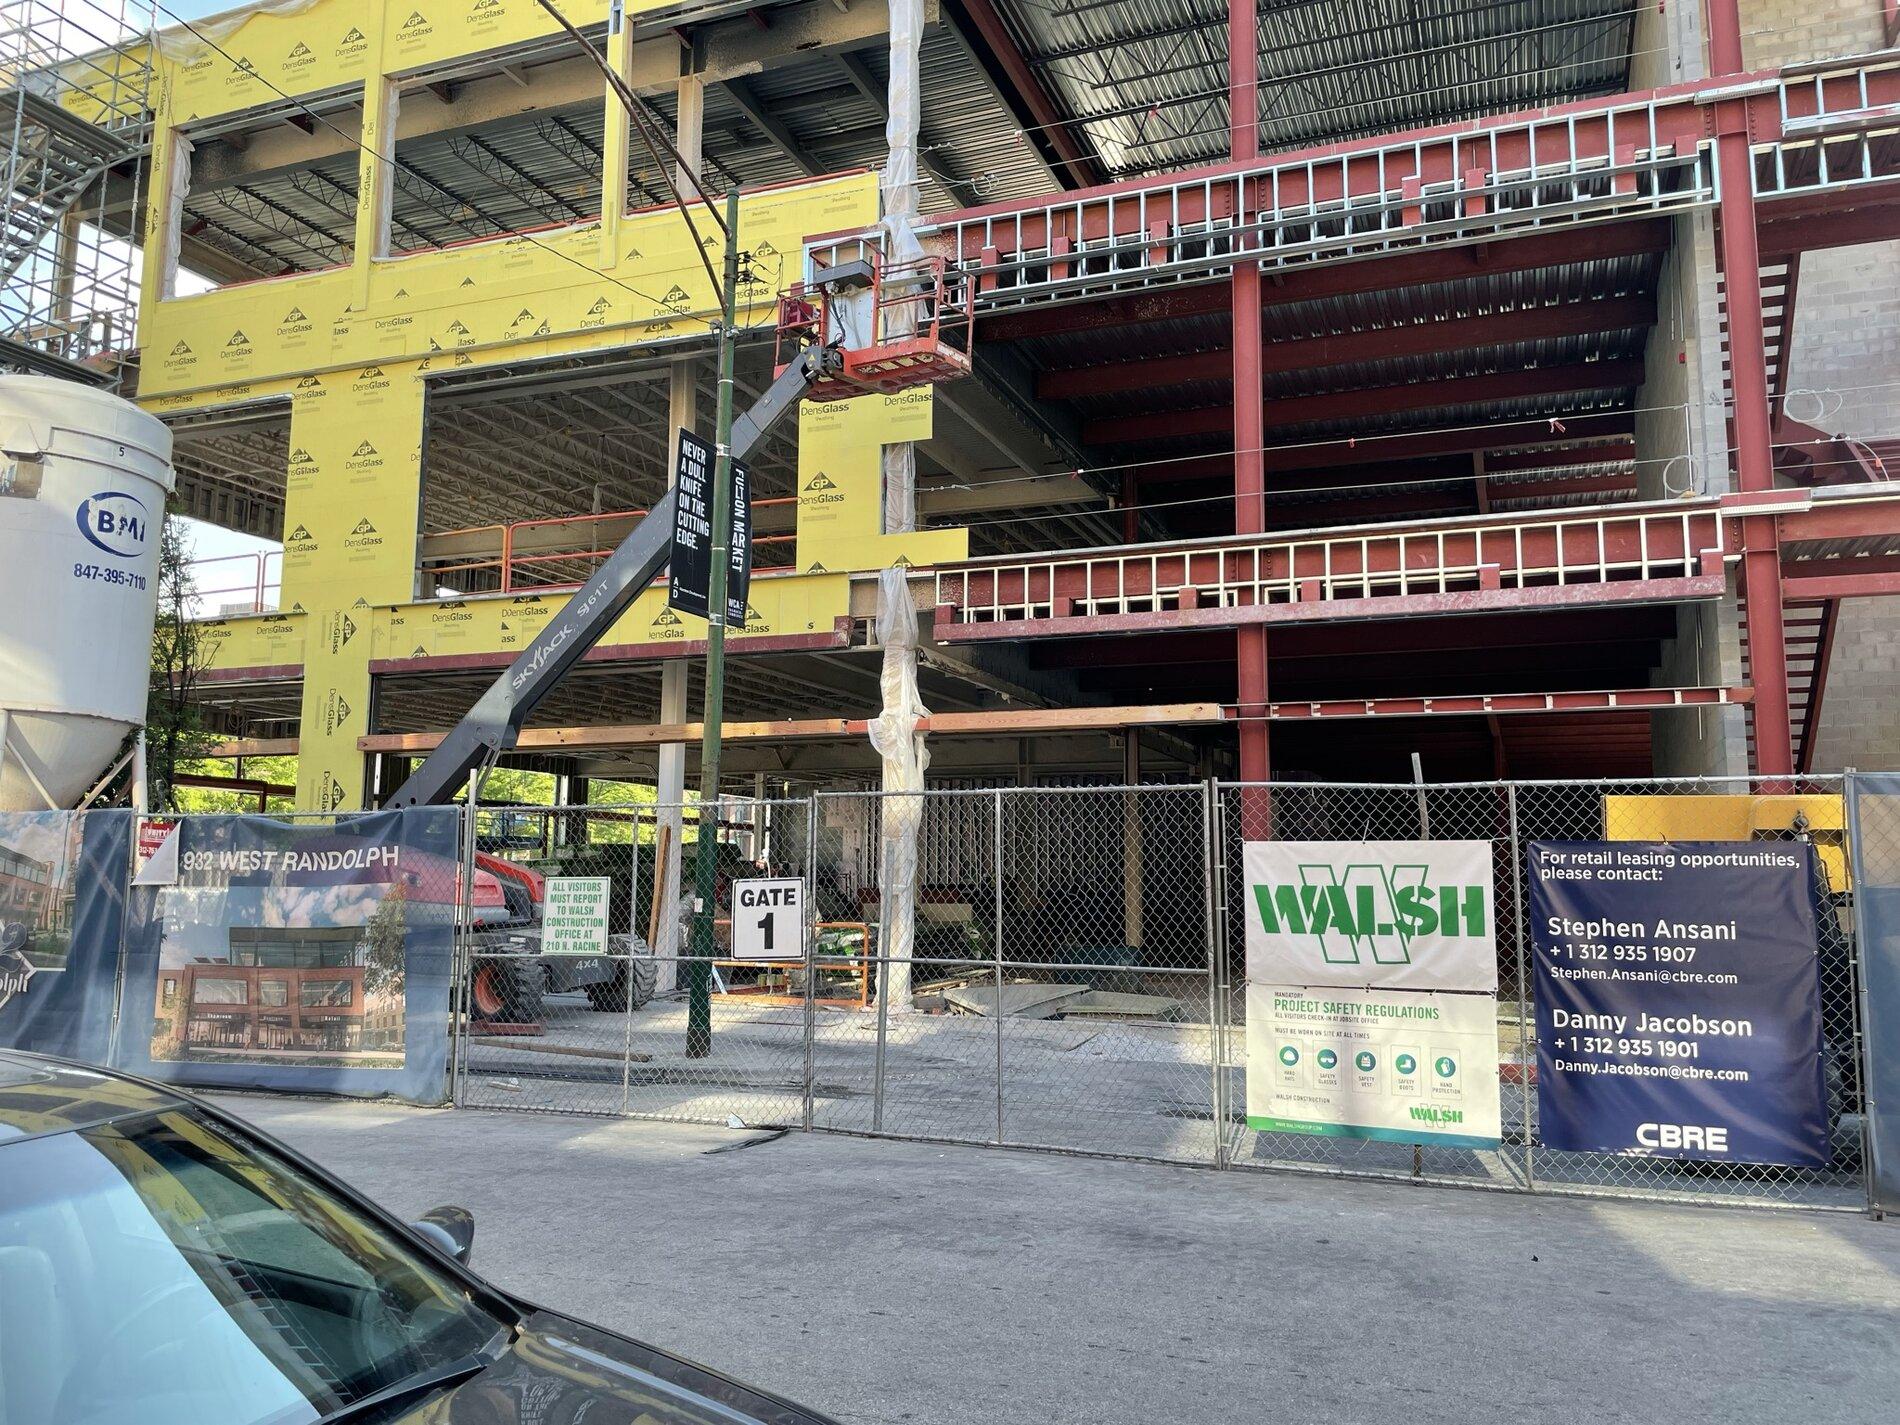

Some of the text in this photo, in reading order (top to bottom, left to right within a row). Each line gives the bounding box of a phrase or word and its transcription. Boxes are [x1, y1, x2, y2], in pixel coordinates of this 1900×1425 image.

[467, 9, 505, 24] DensGlass
[396, 26, 432, 42] DensGlass
[181, 60, 213, 74] DensGlass
[282, 56, 316, 71] DensGlass
[225, 71, 259, 85] DensGlass
[363, 165, 372, 211] DensGlass
[277, 323, 312, 336] DensGlass
[375, 316, 413, 329] DensGlass
[164, 356, 197, 368] DensGlass
[216, 387, 250, 398] DensGlass
[353, 380, 390, 391] DensGlass
[160, 395, 193, 405] DensGlass
[885, 393, 933, 406] DensGlass
[801, 404, 849, 416] DensGlass
[119, 447, 124, 456] 5
[683, 439, 706, 465] NEVER
[346, 458, 383, 469] DensGlass
[681, 457, 707, 482] A DULL
[680, 474, 701, 498] KNIFE
[679, 492, 705, 517] ON THE
[678, 511, 709, 536] CUTTING
[344, 537, 383, 548] DensGlass
[677, 528, 698, 550] EDGE.
[732, 526, 745, 572] MARKET
[74, 563, 146, 590] 847-395-7110
[674, 577, 678, 586] A
[673, 589, 678, 598] D
[433, 613, 472, 622] DensGlass
[257, 625, 293, 634] DensGlass
[512, 625, 572, 689] SKYJACK
[327, 688, 336, 736] DensGlass
[184, 845, 399, 871] 932 WEST RANDOLPH
[1541, 852, 1800, 868] For retail leasing opportunities,
[1541, 867, 1663, 881] please contact:
[552, 883, 601, 891] ALL VISITORS
[550, 894, 602, 903] MUST REPORT
[741, 888, 795, 906] GATE
[557, 906, 594, 915] TO WALSH
[1253, 885, 1486, 939] WALSH
[547, 918, 603, 927] CONSTRUCTION
[1549, 917, 1736, 940] Stephen Ansani
[555, 930, 593, 939] OFFICE AT
[758, 913, 774, 949] 1
[545, 942, 559, 950] 210
[573, 942, 600, 951] RACINE
[1566, 944, 1572, 958] 1
[1579, 945, 1607, 959] 312
[1614, 946, 1647, 961] 935
[1653, 947, 1696, 962] 1907
[1551, 967, 1737, 984] Stephen.Ansani@cbre.com
[1275, 999, 1439, 1020] PROJECT SAFETY REGULATIONS
[1554, 1009, 1752, 1036] Danny Jacobson
[1571, 1037, 1577, 1051] 1
[1584, 1038, 1613, 1054] 312
[1618, 1040, 1651, 1056] 935
[1658, 1040, 1699, 1058] 1901
[1555, 1060, 1748, 1081] Danny.Jacobson@cbre.com
[1410, 1107, 1462, 1123] WALSH
[1636, 1123, 1728, 1152] CBRE
